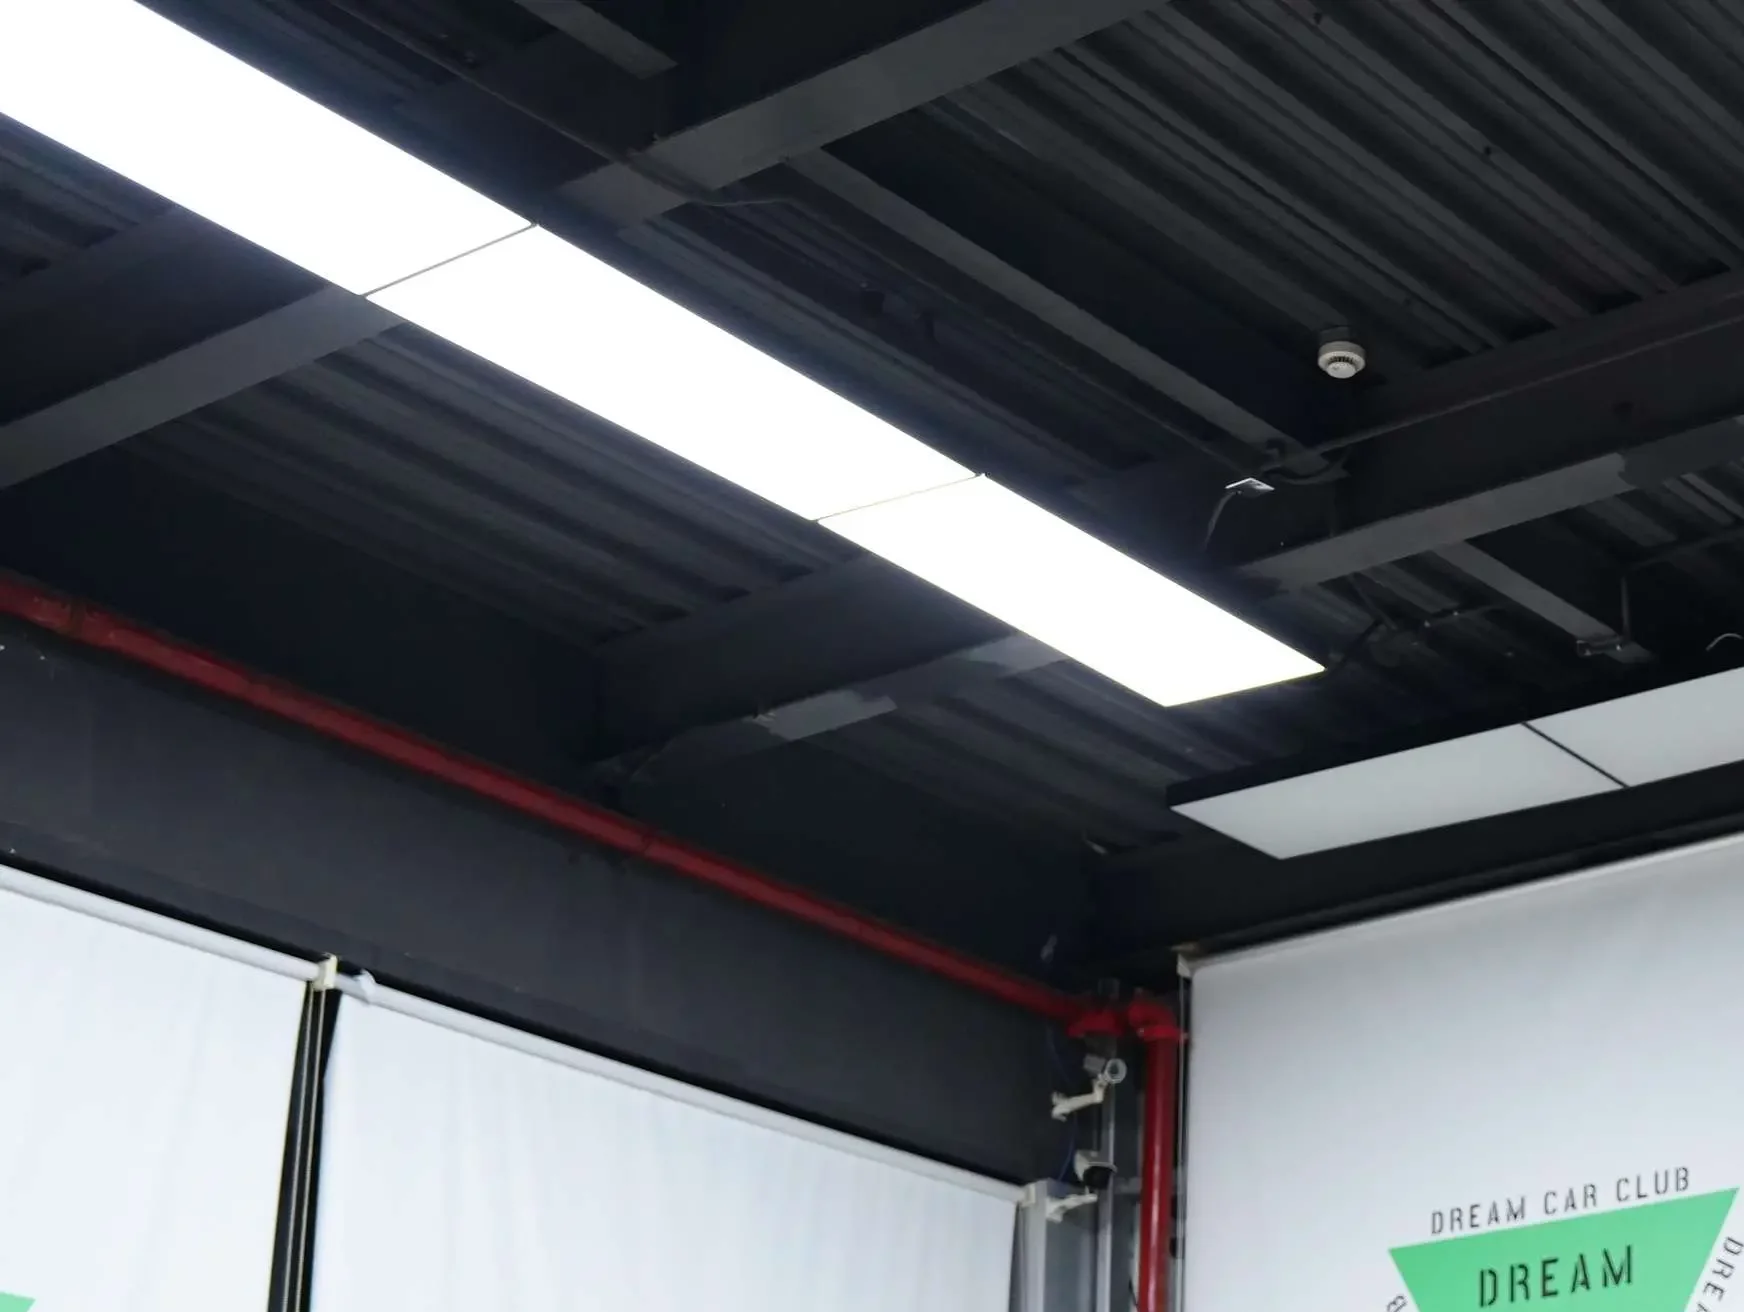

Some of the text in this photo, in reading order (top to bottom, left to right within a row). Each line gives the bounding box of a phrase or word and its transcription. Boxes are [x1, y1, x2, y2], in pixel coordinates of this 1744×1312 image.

[1430, 1166, 1690, 1235] DREAM CAR CLUB
[1478, 1244, 1634, 1308] DREAM
